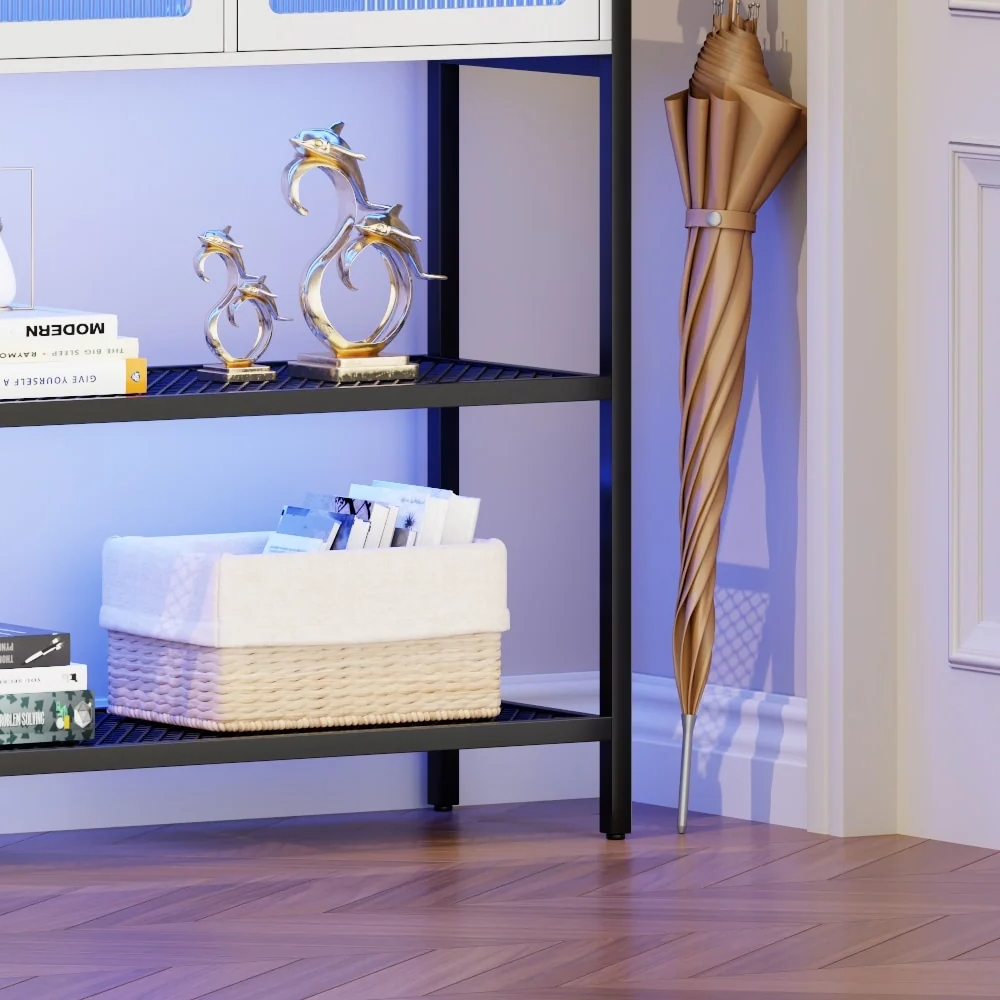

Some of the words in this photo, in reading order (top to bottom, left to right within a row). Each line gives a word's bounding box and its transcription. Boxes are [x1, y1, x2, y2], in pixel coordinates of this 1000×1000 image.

[26, 322, 105, 337] MODERN
[52, 349, 80, 357] SLEEP
[3, 378, 10, 387] A
[14, 376, 68, 387] YOURSELF
[72, 375, 97, 384] GIVE
[21, 712, 45, 726] SOLVING
